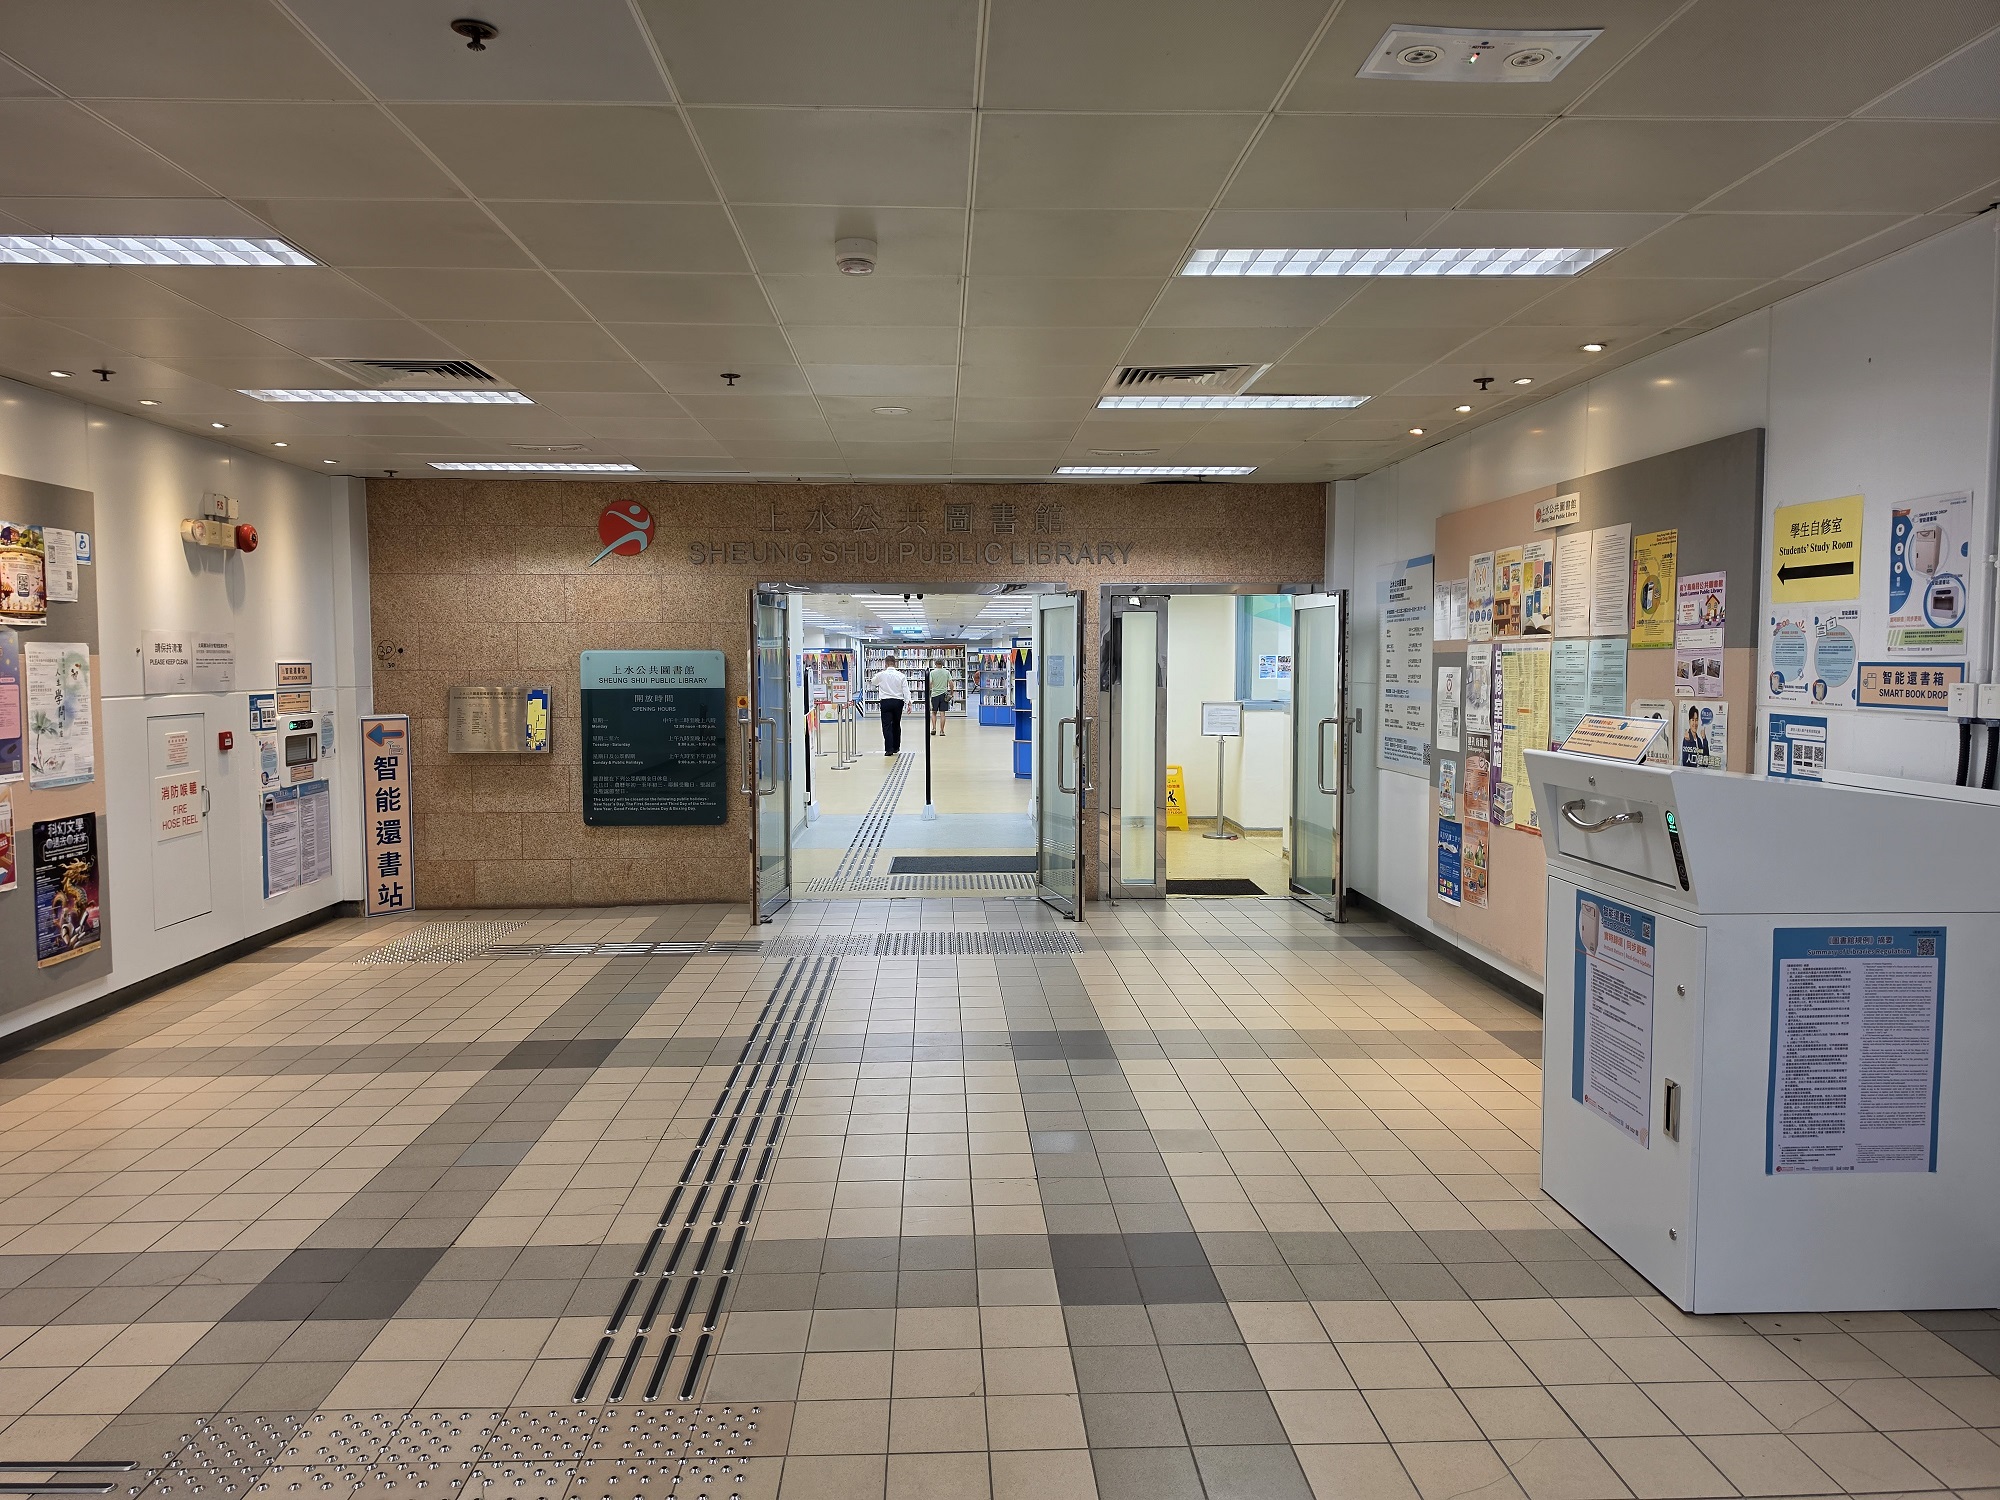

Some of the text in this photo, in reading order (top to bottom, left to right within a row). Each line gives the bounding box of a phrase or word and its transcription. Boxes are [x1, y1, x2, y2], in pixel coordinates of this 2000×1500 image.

[758, 502, 1065, 535] 上水公共圖書館
[1790, 517, 1843, 539] 學生自修室
[689, 542, 1135, 564] SHEUNG SHUI PUBLIC LIBRARY
[1810, 542, 1830, 553] Study
[1832, 540, 1853, 550] Room
[612, 665, 695, 675] 上水公共圖書館
[1882, 670, 1945, 686] 智能還書箱
[1879, 688, 1948, 699] SMART BOOK DROP
[172, 804, 188, 815] FIRE
[47, 817, 85, 836] 科幻文學
[162, 815, 199, 830] HOSE REEL
[373, 755, 403, 908] 智能還書站
[1877, 936, 1893, 944] 摘要
[1807, 949, 1837, 957] Summary
[1846, 948, 1875, 956] Libraries
[1876, 948, 1911, 957] Regulation
